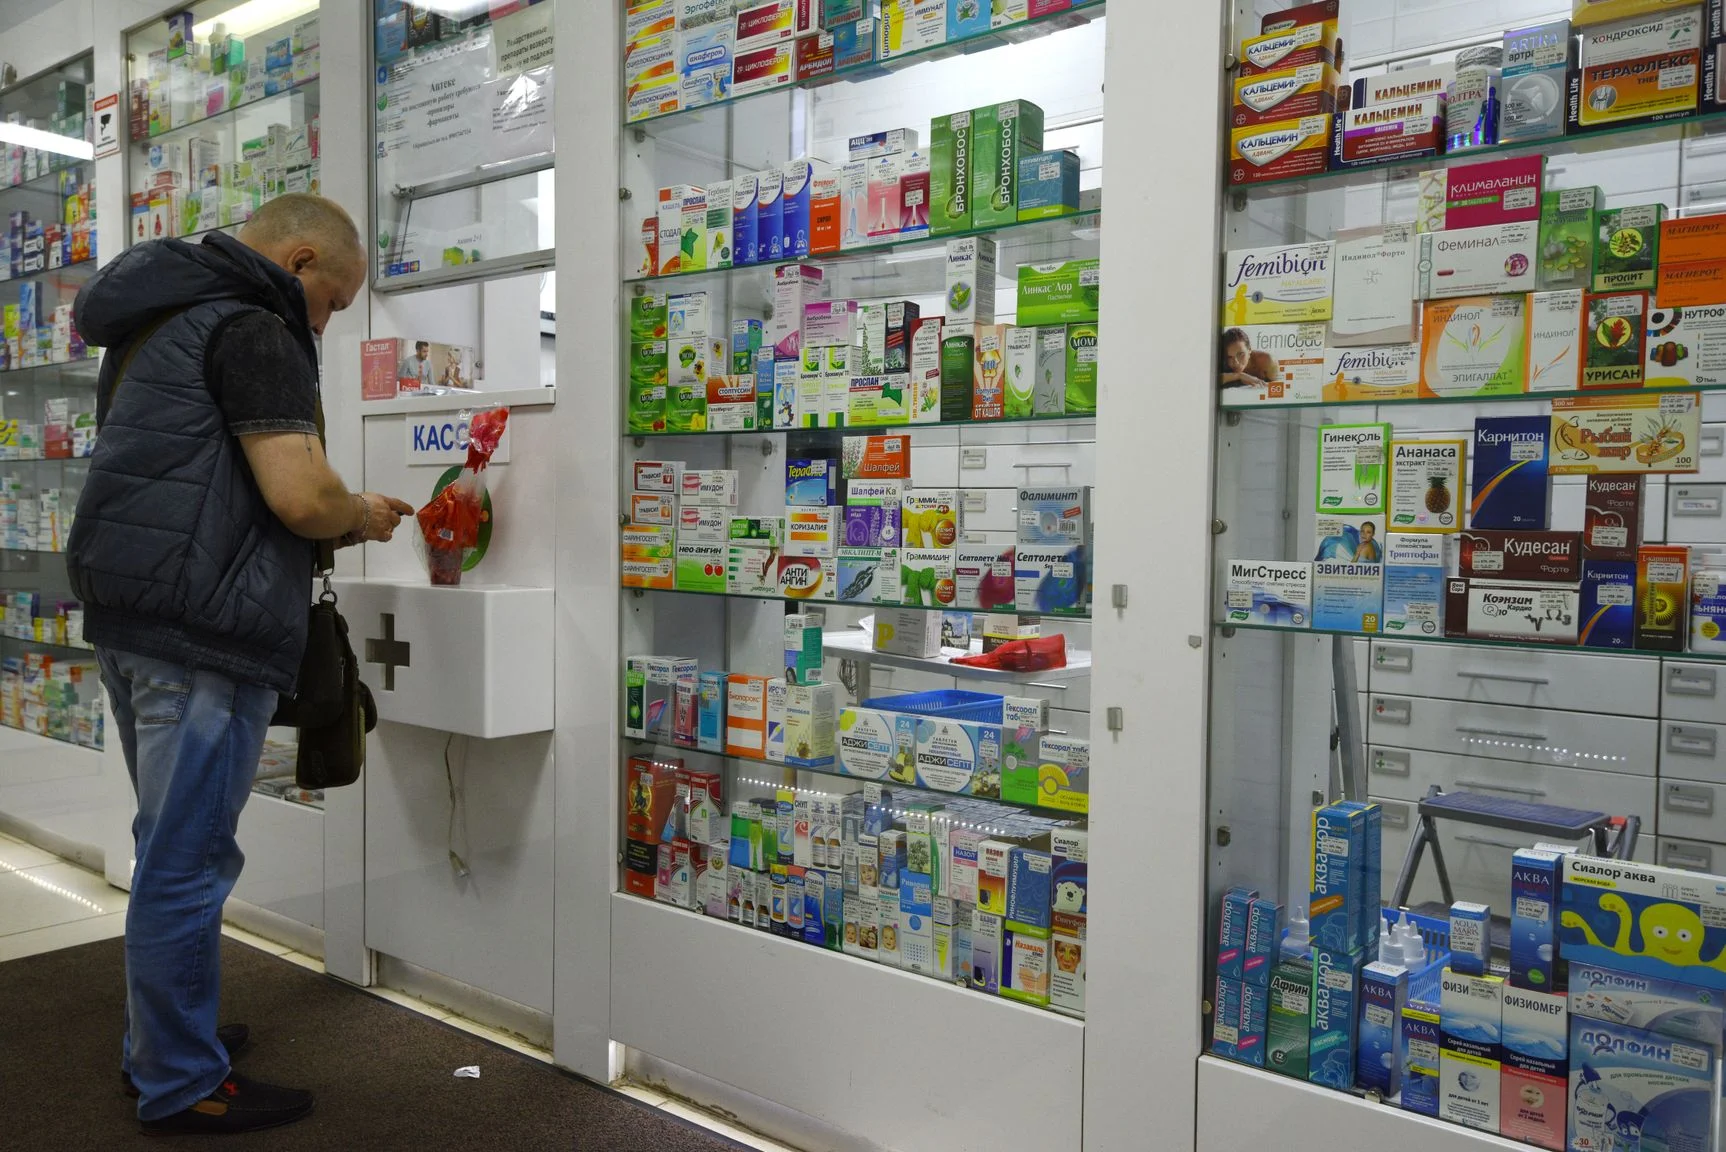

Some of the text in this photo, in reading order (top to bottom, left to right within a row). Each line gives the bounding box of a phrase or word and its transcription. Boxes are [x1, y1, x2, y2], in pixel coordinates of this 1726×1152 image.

[914, 3, 945, 17] ИММУНАЛ
[748, 11, 788, 28] ЦИКЛОФЕРОН
[1591, 23, 1664, 45] ХОНДРОКСИД
[1248, 39, 1296, 55] КАЛЬЦЕМИН
[689, 48, 723, 63] анаферон
[748, 56, 785, 72] ЦИКЛОФЕРОН
[799, 57, 833, 73] АРБИДОЛ
[1590, 55, 1692, 83] ТЕРАФЛЕКС
[1704, 54, 1715, 102] Health Life
[1243, 80, 1297, 97] КАЛЬЦЕМИН
[1375, 78, 1443, 102] КАЛЬЦЕМИН
[1504, 102, 1515, 110] 500
[1568, 77, 1580, 122] Health Life
[1354, 103, 1423, 126] КАЛЬЦЕМИН
[850, 137, 866, 147] АЦЦ
[1240, 133, 1299, 150] КАЛЬЦЕМИН
[1334, 116, 1342, 156] Health Life
[1001, 117, 1012, 204] БРОНХОБОС
[955, 129, 967, 213] БРОНХОБОС
[1450, 173, 1537, 199] КЛИМАЛАНИН
[683, 195, 706, 204] ПРОСПАН
[1667, 222, 1721, 236] МАГНЕРОТ
[1437, 234, 1500, 252] Феминал
[948, 253, 974, 265] Линкас
[1228, 253, 1326, 287] femibion
[1664, 267, 1720, 280] МАГНЕРОТ
[1603, 272, 1645, 284] ПРОЛИТ
[1022, 281, 1073, 297] Линкас Лор
[1433, 311, 1482, 330] ИНДИНОЛ
[1684, 307, 1725, 320] НУТРОФ
[1533, 329, 1577, 340] ИНДИНОЛ
[943, 339, 968, 348] Линкас
[1072, 336, 1097, 348] МОМ
[850, 375, 880, 388] ПРОСПАН
[1452, 371, 1510, 384] ЭПИГАЛЛАТ
[1586, 367, 1642, 382] УРИСАН
[1323, 432, 1382, 446] Гинеколь
[1477, 429, 1546, 446] Карнитон
[1580, 426, 1632, 445] Рыбий
[1395, 445, 1457, 459] Ананаса
[1597, 445, 1633, 461] жир
[1395, 460, 1427, 468] экстракт
[1675, 456, 1692, 464] 100
[863, 462, 901, 474] Шалфей
[850, 486, 897, 496] Шалфей Ка
[1588, 480, 1637, 493] Кудесан
[1020, 489, 1079, 501] Фалиминт
[1512, 515, 1521, 523] 20
[790, 523, 828, 531] КОРИЗАЛИЯ
[1399, 536, 1429, 545] Формула
[1503, 538, 1572, 556] Кудесан
[906, 552, 951, 562] Граммидин
[958, 553, 995, 562] Септолете
[1017, 553, 1069, 564] Септолете
[1389, 549, 1441, 561] Триптофан
[784, 568, 808, 577] АНТИ
[1231, 563, 1307, 580] МигСтресс
[1316, 564, 1380, 577] ЭВИТАЛИЯ
[1586, 570, 1629, 580] Карнитон
[780, 576, 807, 586] АНГИН
[1483, 593, 1533, 605] Коэнзим
[1507, 603, 1533, 612] Кардио
[1365, 614, 1376, 623] 20
[1006, 702, 1038, 715] Гексорал
[899, 719, 910, 729] 24
[983, 729, 995, 739] 24
[842, 737, 890, 752] АДЖИСЕПТ
[1041, 740, 1071, 752] Гексорал
[919, 754, 972, 770] АДЖИСЕПТ
[1054, 836, 1079, 847] Сиалор
[1315, 817, 1329, 895] аквалор
[1513, 871, 1550, 887] АКВА
[1571, 860, 1657, 884] Сиалор аква
[1221, 900, 1234, 947] аквалор
[1249, 907, 1261, 954] аквалор
[1453, 919, 1478, 930] AQUA
[1272, 976, 1310, 996] Африн
[1316, 951, 1332, 1031] аквалор
[1362, 984, 1392, 1000] АКВА
[1218, 979, 1228, 1027] аквалор
[1243, 982, 1254, 1034] аквалор
[1503, 994, 1563, 1016] ФИЗИОМЕР
[1405, 1021, 1436, 1036] АКВА
[1447, 1037, 1463, 1047] Спрей
[1580, 1028, 1671, 1061] ДОЛФИН
[1509, 1053, 1526, 1064] Спрей
[1578, 1137, 1590, 1147] 30
